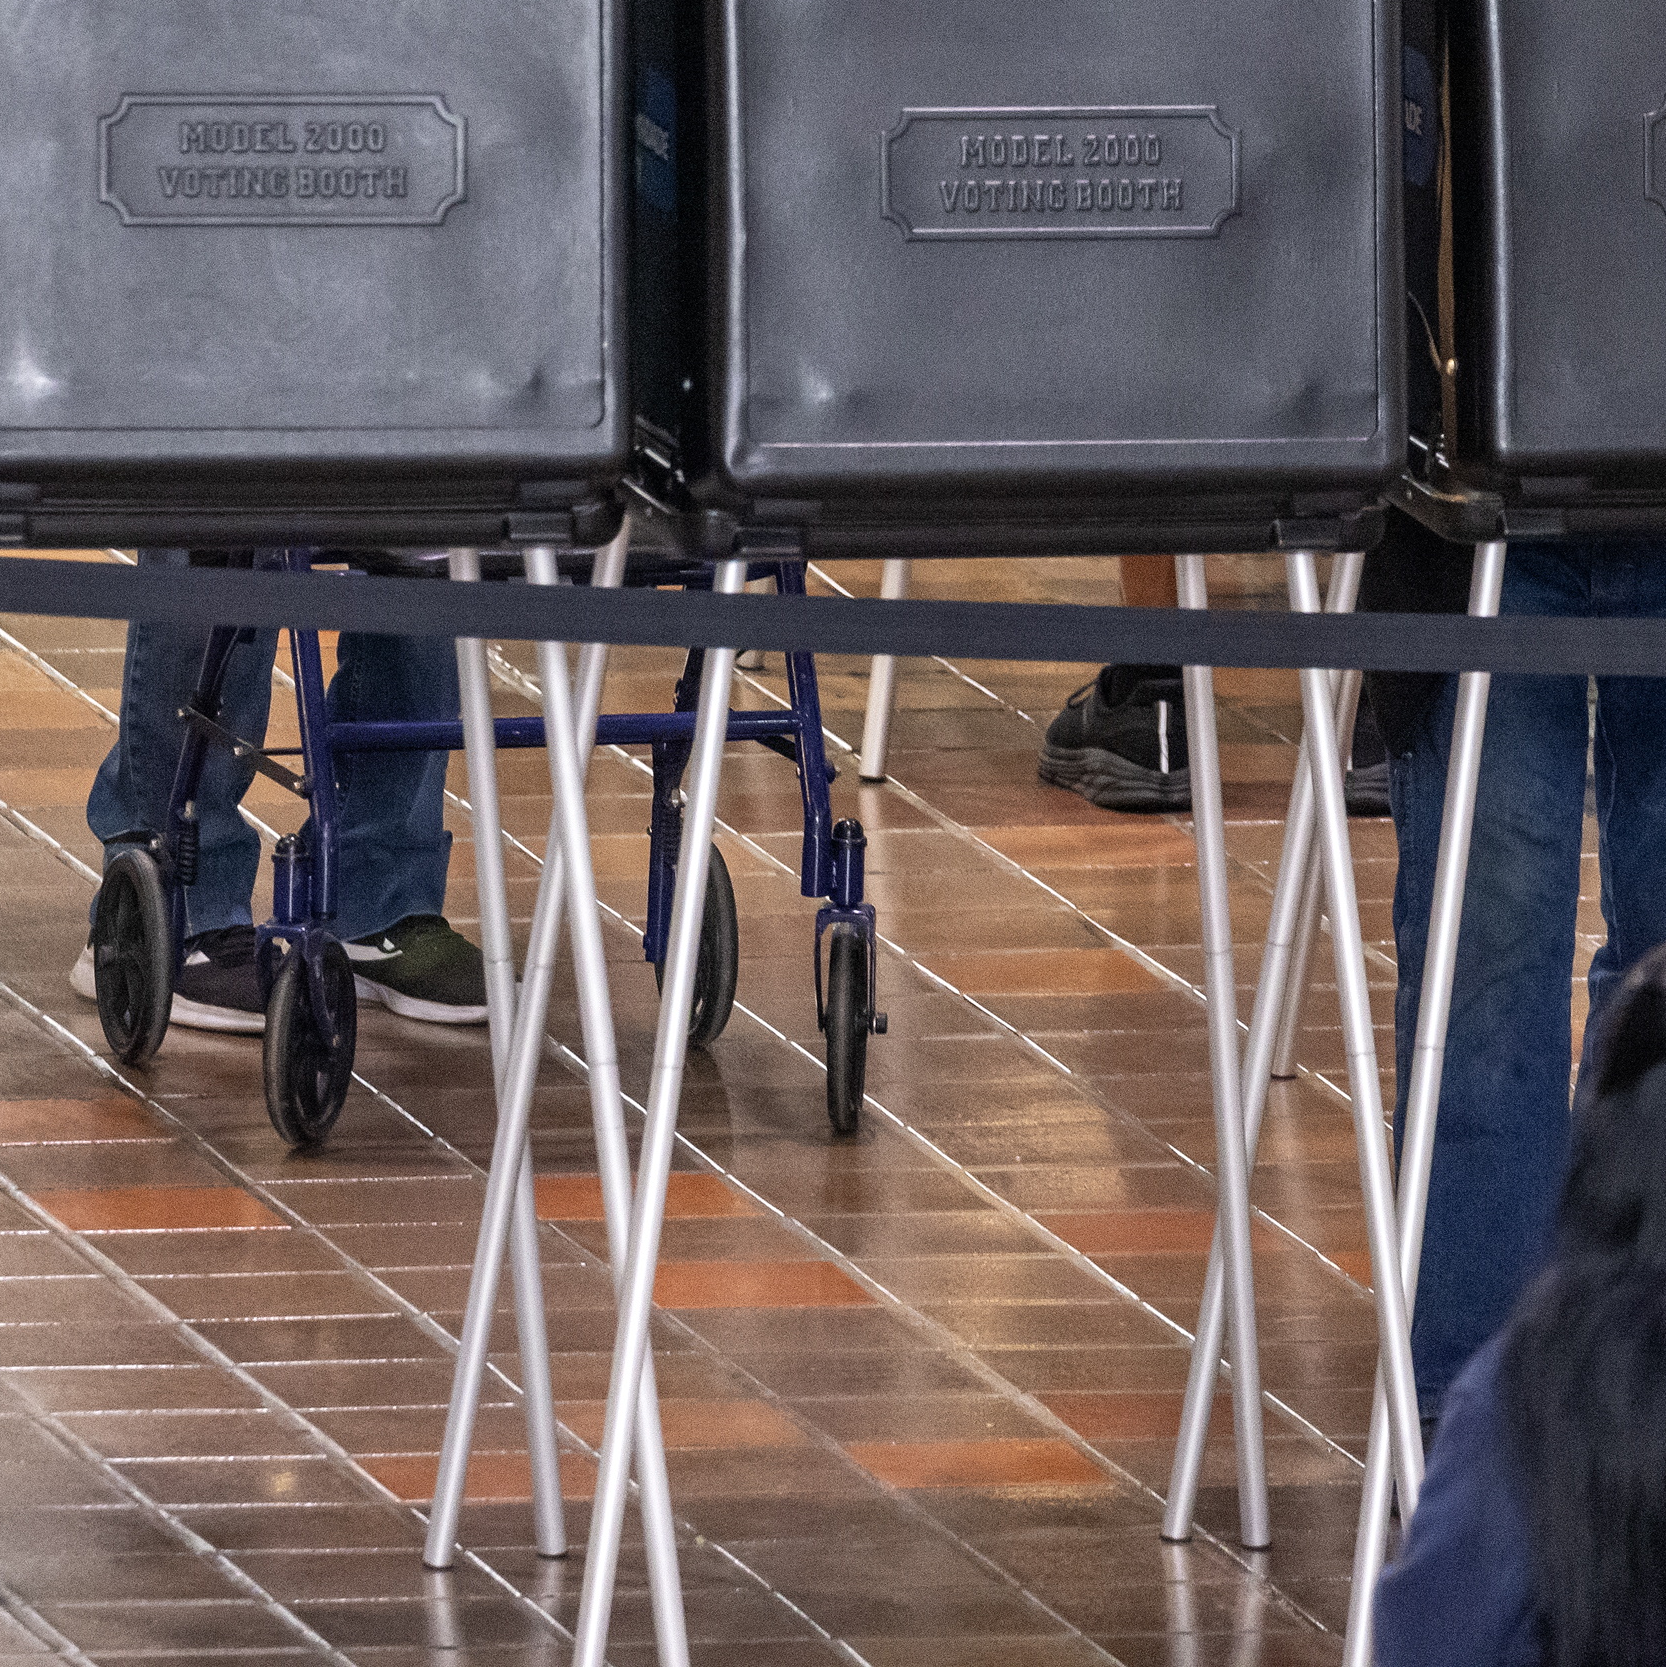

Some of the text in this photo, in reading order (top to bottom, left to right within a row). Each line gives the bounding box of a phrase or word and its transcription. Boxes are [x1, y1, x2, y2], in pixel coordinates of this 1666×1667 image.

[177, 121, 388, 154] MODEL 2000
[959, 133, 1162, 168] MODEL 2000
[157, 165, 410, 198] VOTING BOOTH
[939, 178, 1183, 213] VOTING BOOTH
